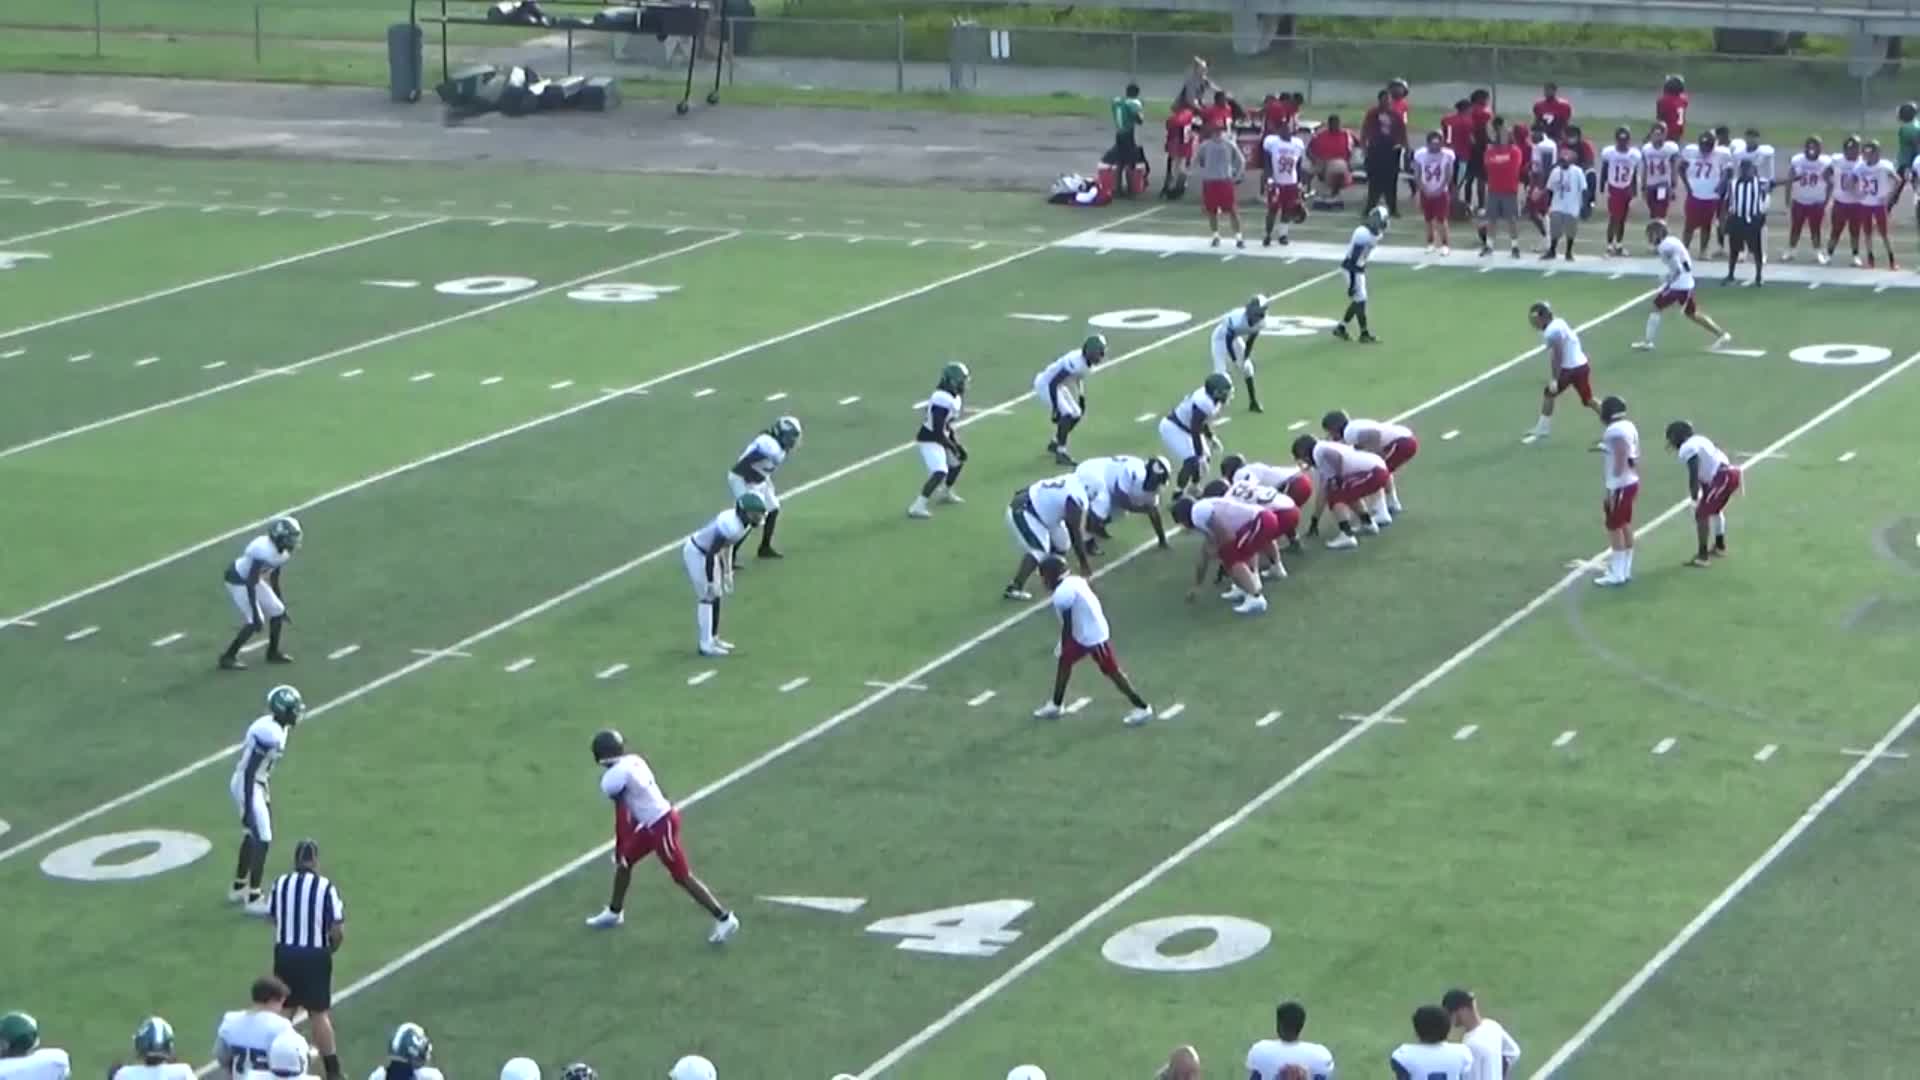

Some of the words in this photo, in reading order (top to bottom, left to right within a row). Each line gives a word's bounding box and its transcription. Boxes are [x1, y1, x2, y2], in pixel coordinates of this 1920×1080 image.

[1424, 164, 1441, 181] 54
[1615, 164, 1630, 182] 12
[1695, 162, 1712, 179] 77
